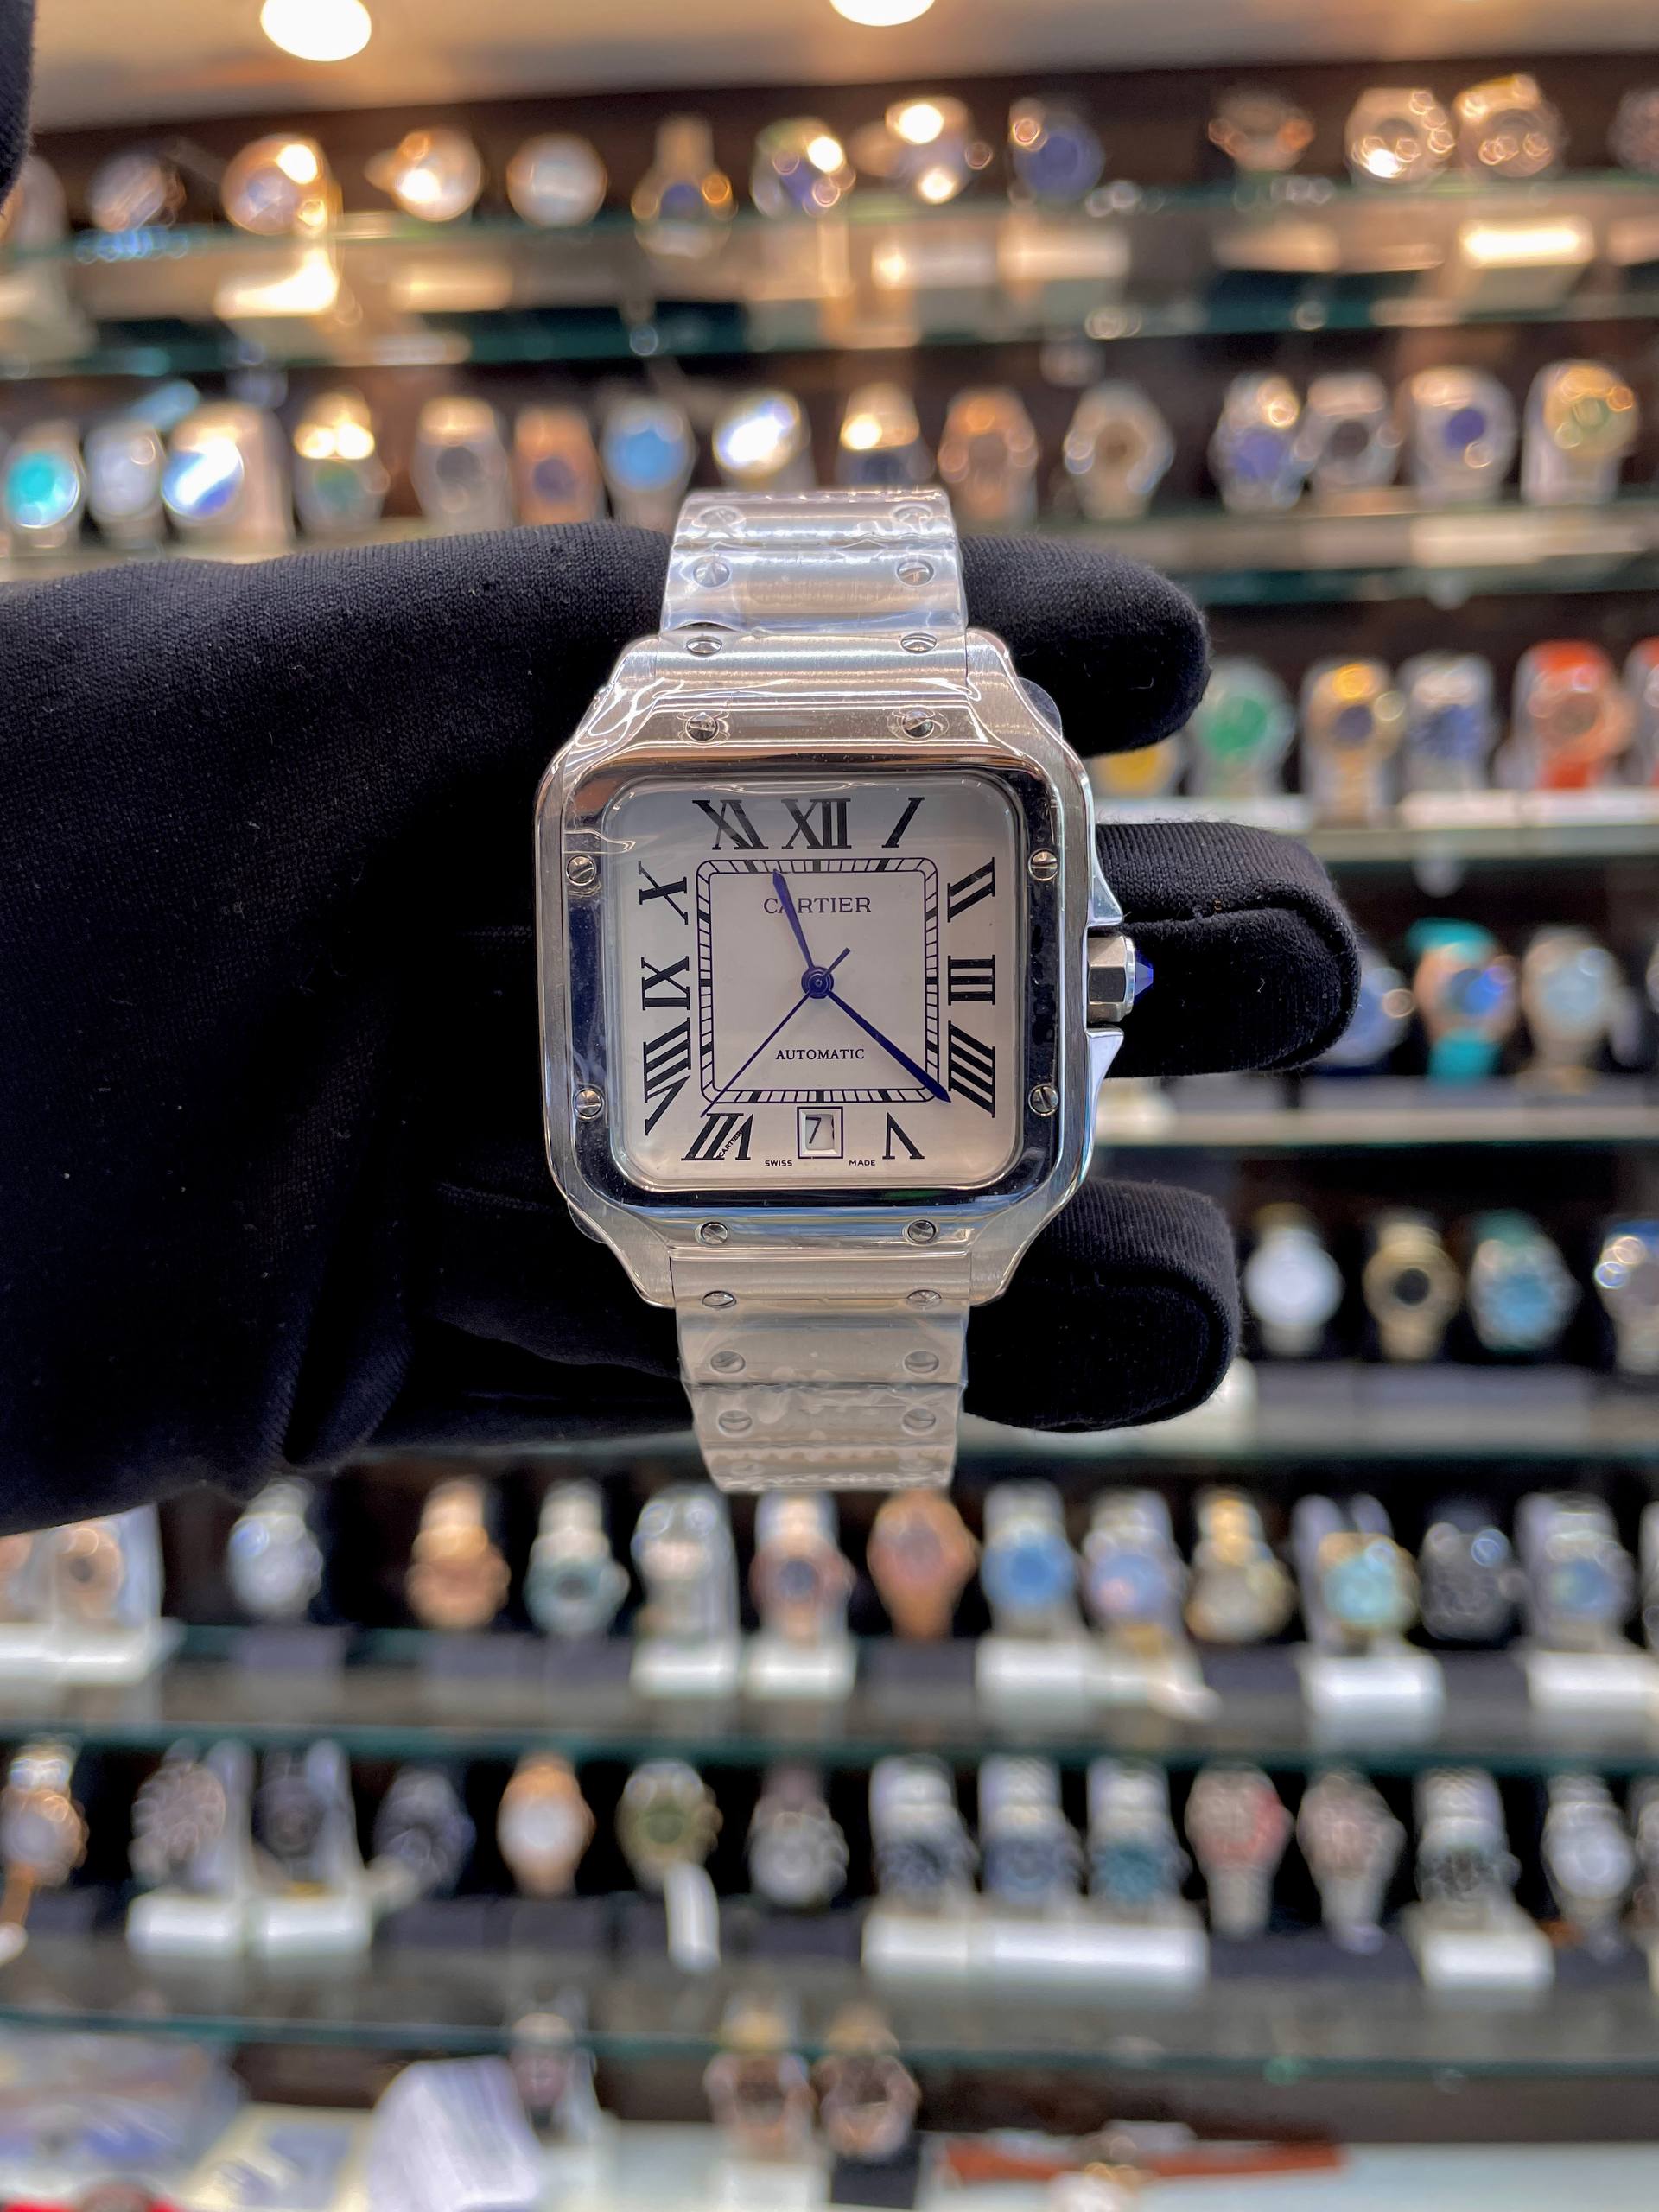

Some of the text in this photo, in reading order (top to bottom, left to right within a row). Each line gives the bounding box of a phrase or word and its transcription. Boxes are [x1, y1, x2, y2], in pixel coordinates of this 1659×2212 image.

[781, 798, 851, 849] XII
[638, 860, 689, 925] X
[763, 897, 872, 914] CRTIER
[947, 857, 995, 923] II
[641, 956, 690, 1010] IX
[947, 954, 995, 1006] III
[643, 1017, 691, 1136] VIII
[776, 1048, 865, 1060] AUTOMATIC
[948, 1020, 995, 1118] IIII
